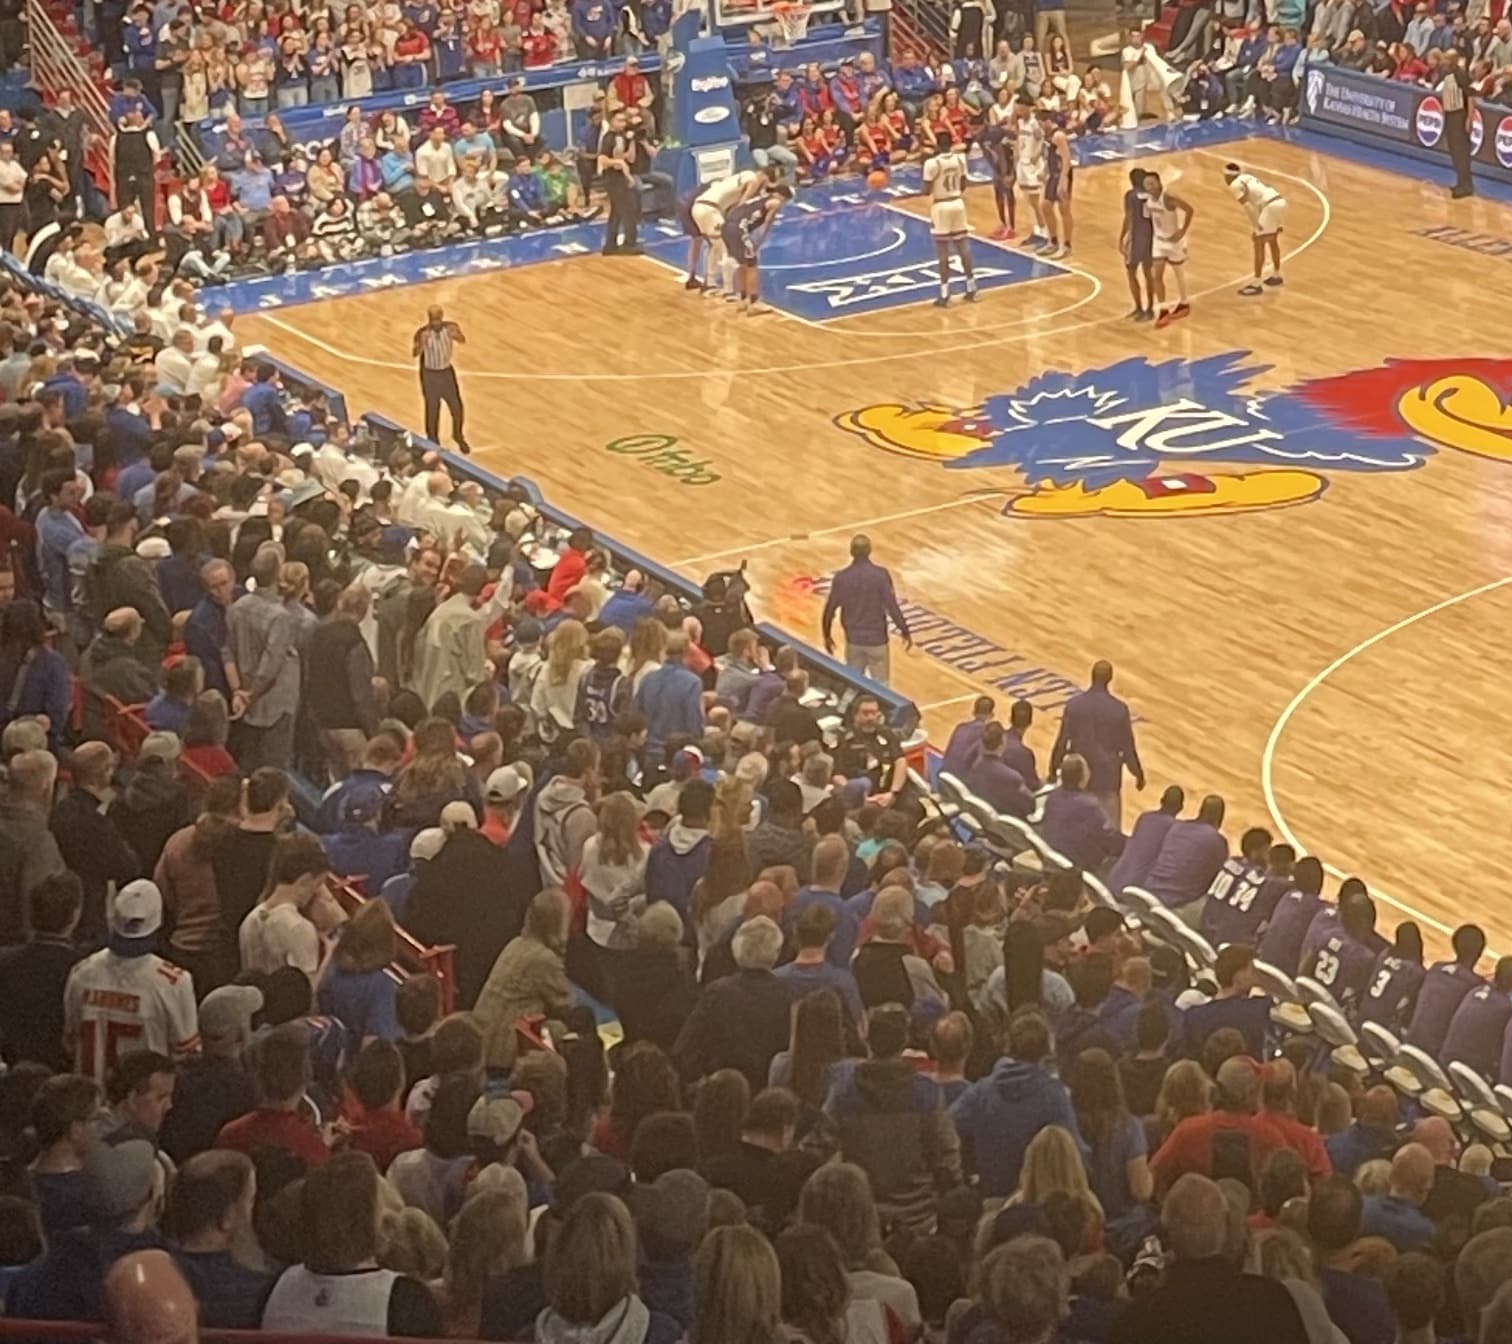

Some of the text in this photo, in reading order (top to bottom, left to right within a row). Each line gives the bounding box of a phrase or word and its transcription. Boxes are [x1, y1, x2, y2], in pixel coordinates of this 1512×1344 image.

[1087, 399, 1285, 454] KU
[1315, 949, 1340, 986] 23
[1371, 969, 1391, 998] 3
